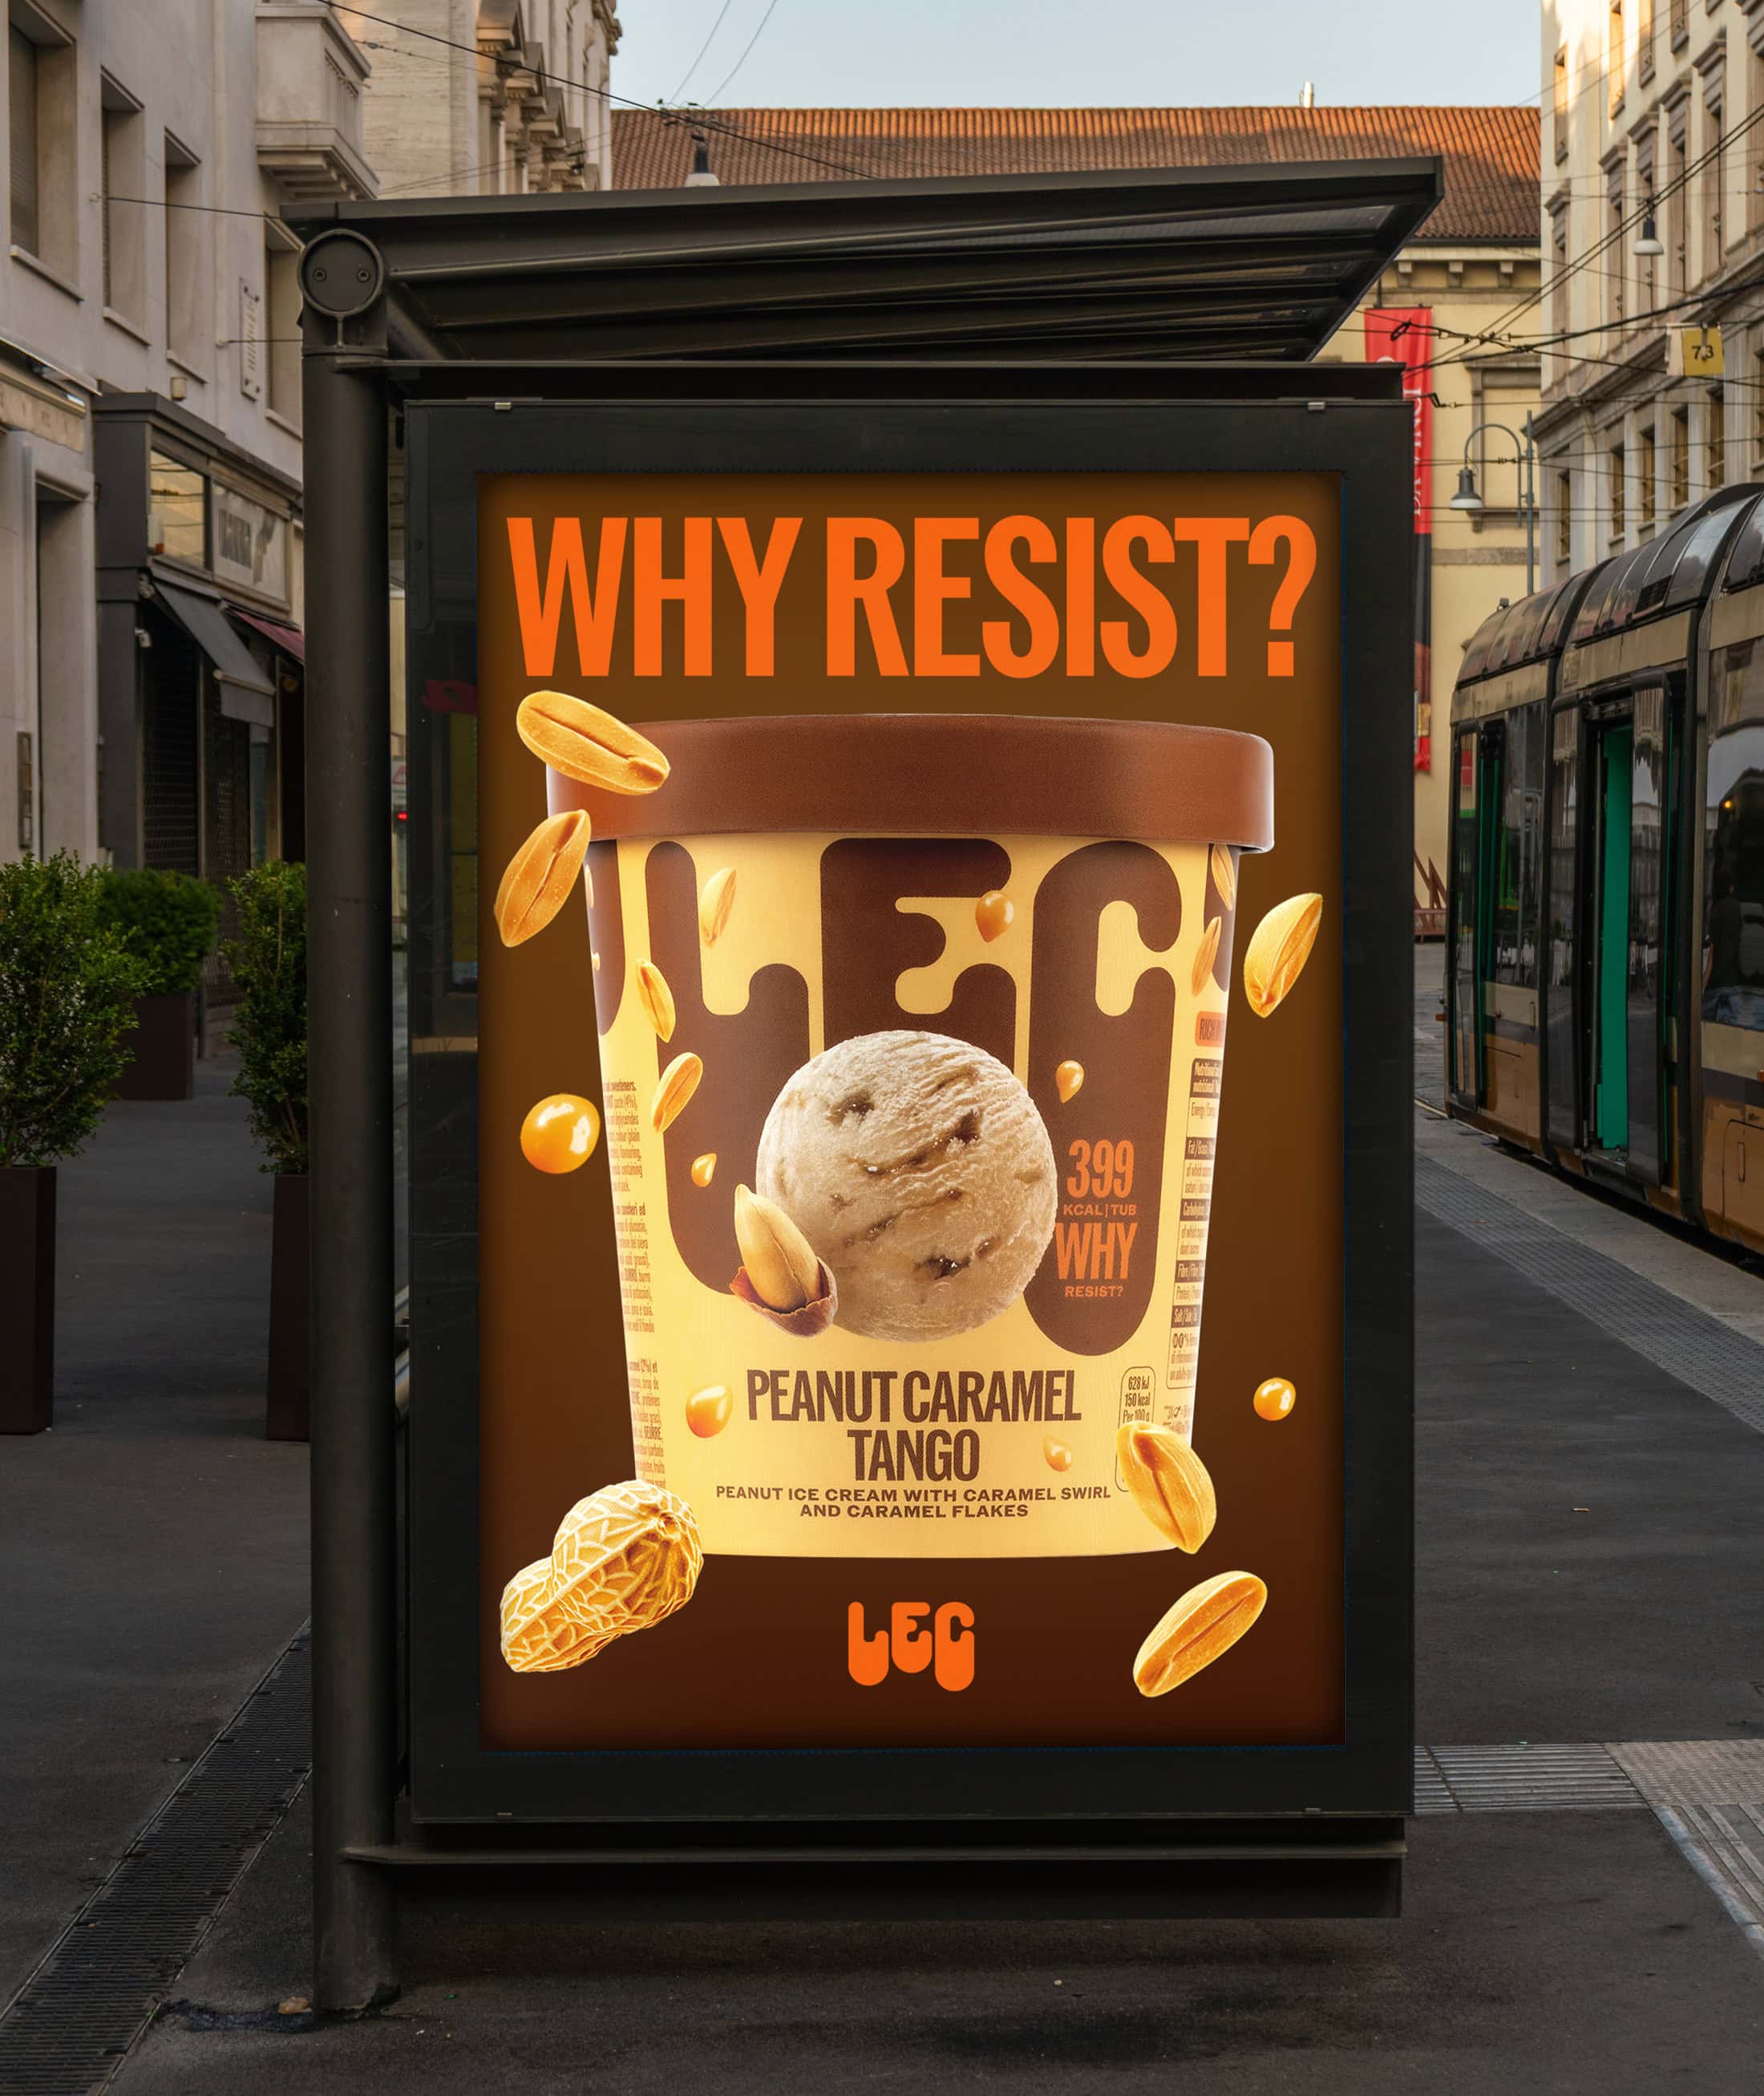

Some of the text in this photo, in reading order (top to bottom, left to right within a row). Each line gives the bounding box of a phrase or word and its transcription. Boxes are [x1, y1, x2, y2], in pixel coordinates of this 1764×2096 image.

[507, 515, 1317, 678] WHY RESIST?
[1067, 1139, 1134, 1198] 399
[1054, 1222, 1138, 1280] WHY
[1065, 1285, 1123, 1297] RESIST?
[652, 1360, 658, 1374] et
[1128, 1376, 1141, 1390] 628
[746, 1370, 1082, 1422] PEANUT CARAMEL
[1125, 1393, 1151, 1406] 150 kcal
[1123, 1410, 1134, 1423] Per
[847, 1429, 980, 1482] TANGO
[716, 1486, 1111, 1503] PEANUT ICE CREAM WITH CARAMEL SWIRL
[800, 1503, 1029, 1519] AND CARAMEL FLAKES
[848, 1601, 975, 1692] LEC
